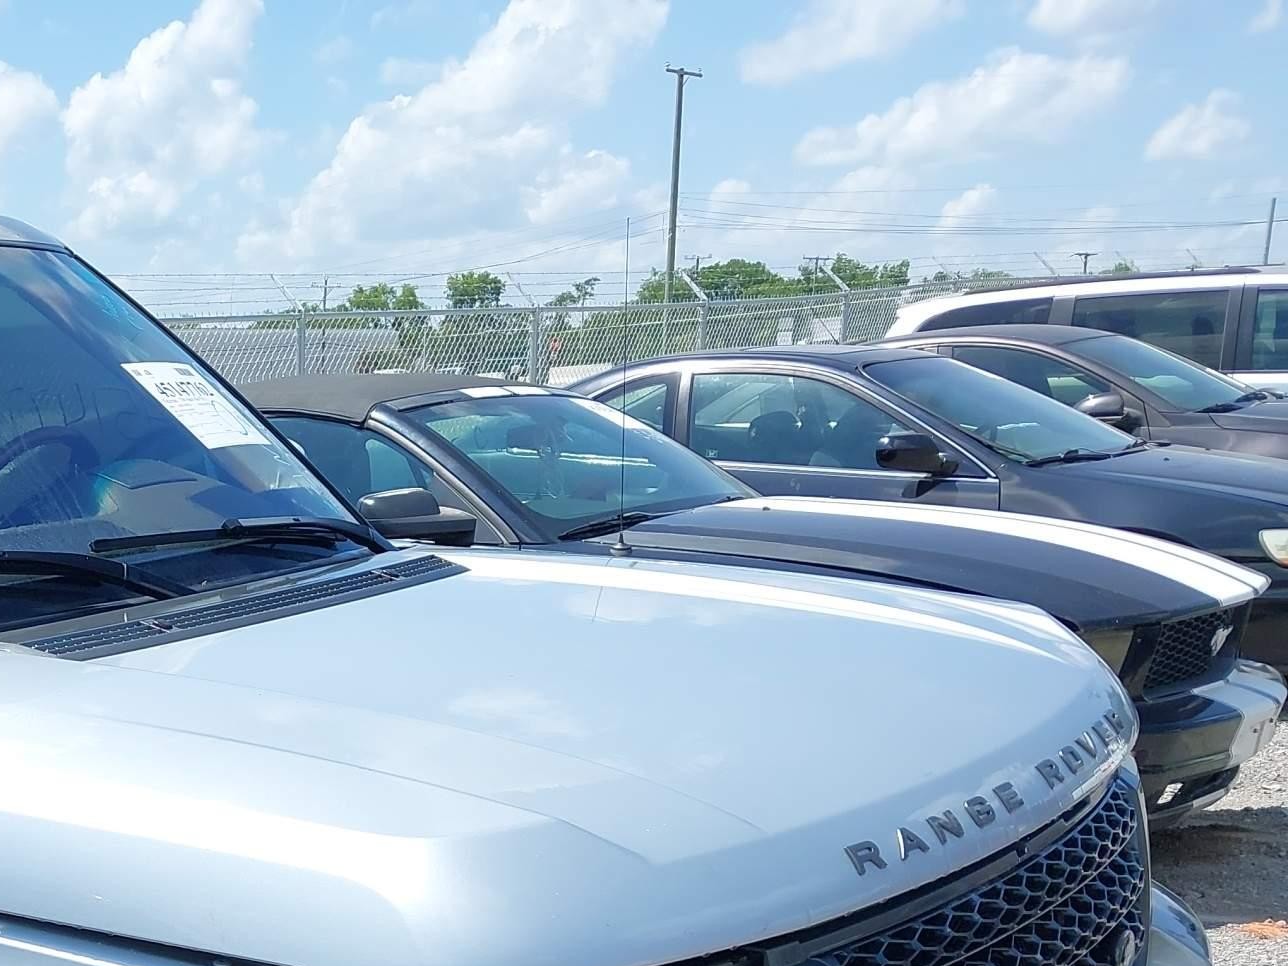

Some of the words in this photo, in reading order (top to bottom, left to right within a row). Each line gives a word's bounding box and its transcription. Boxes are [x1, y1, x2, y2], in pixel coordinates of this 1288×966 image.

[154, 381, 215, 398] 45147762
[843, 781, 1025, 877] RANGE
[1034, 708, 1125, 790] ROVER
